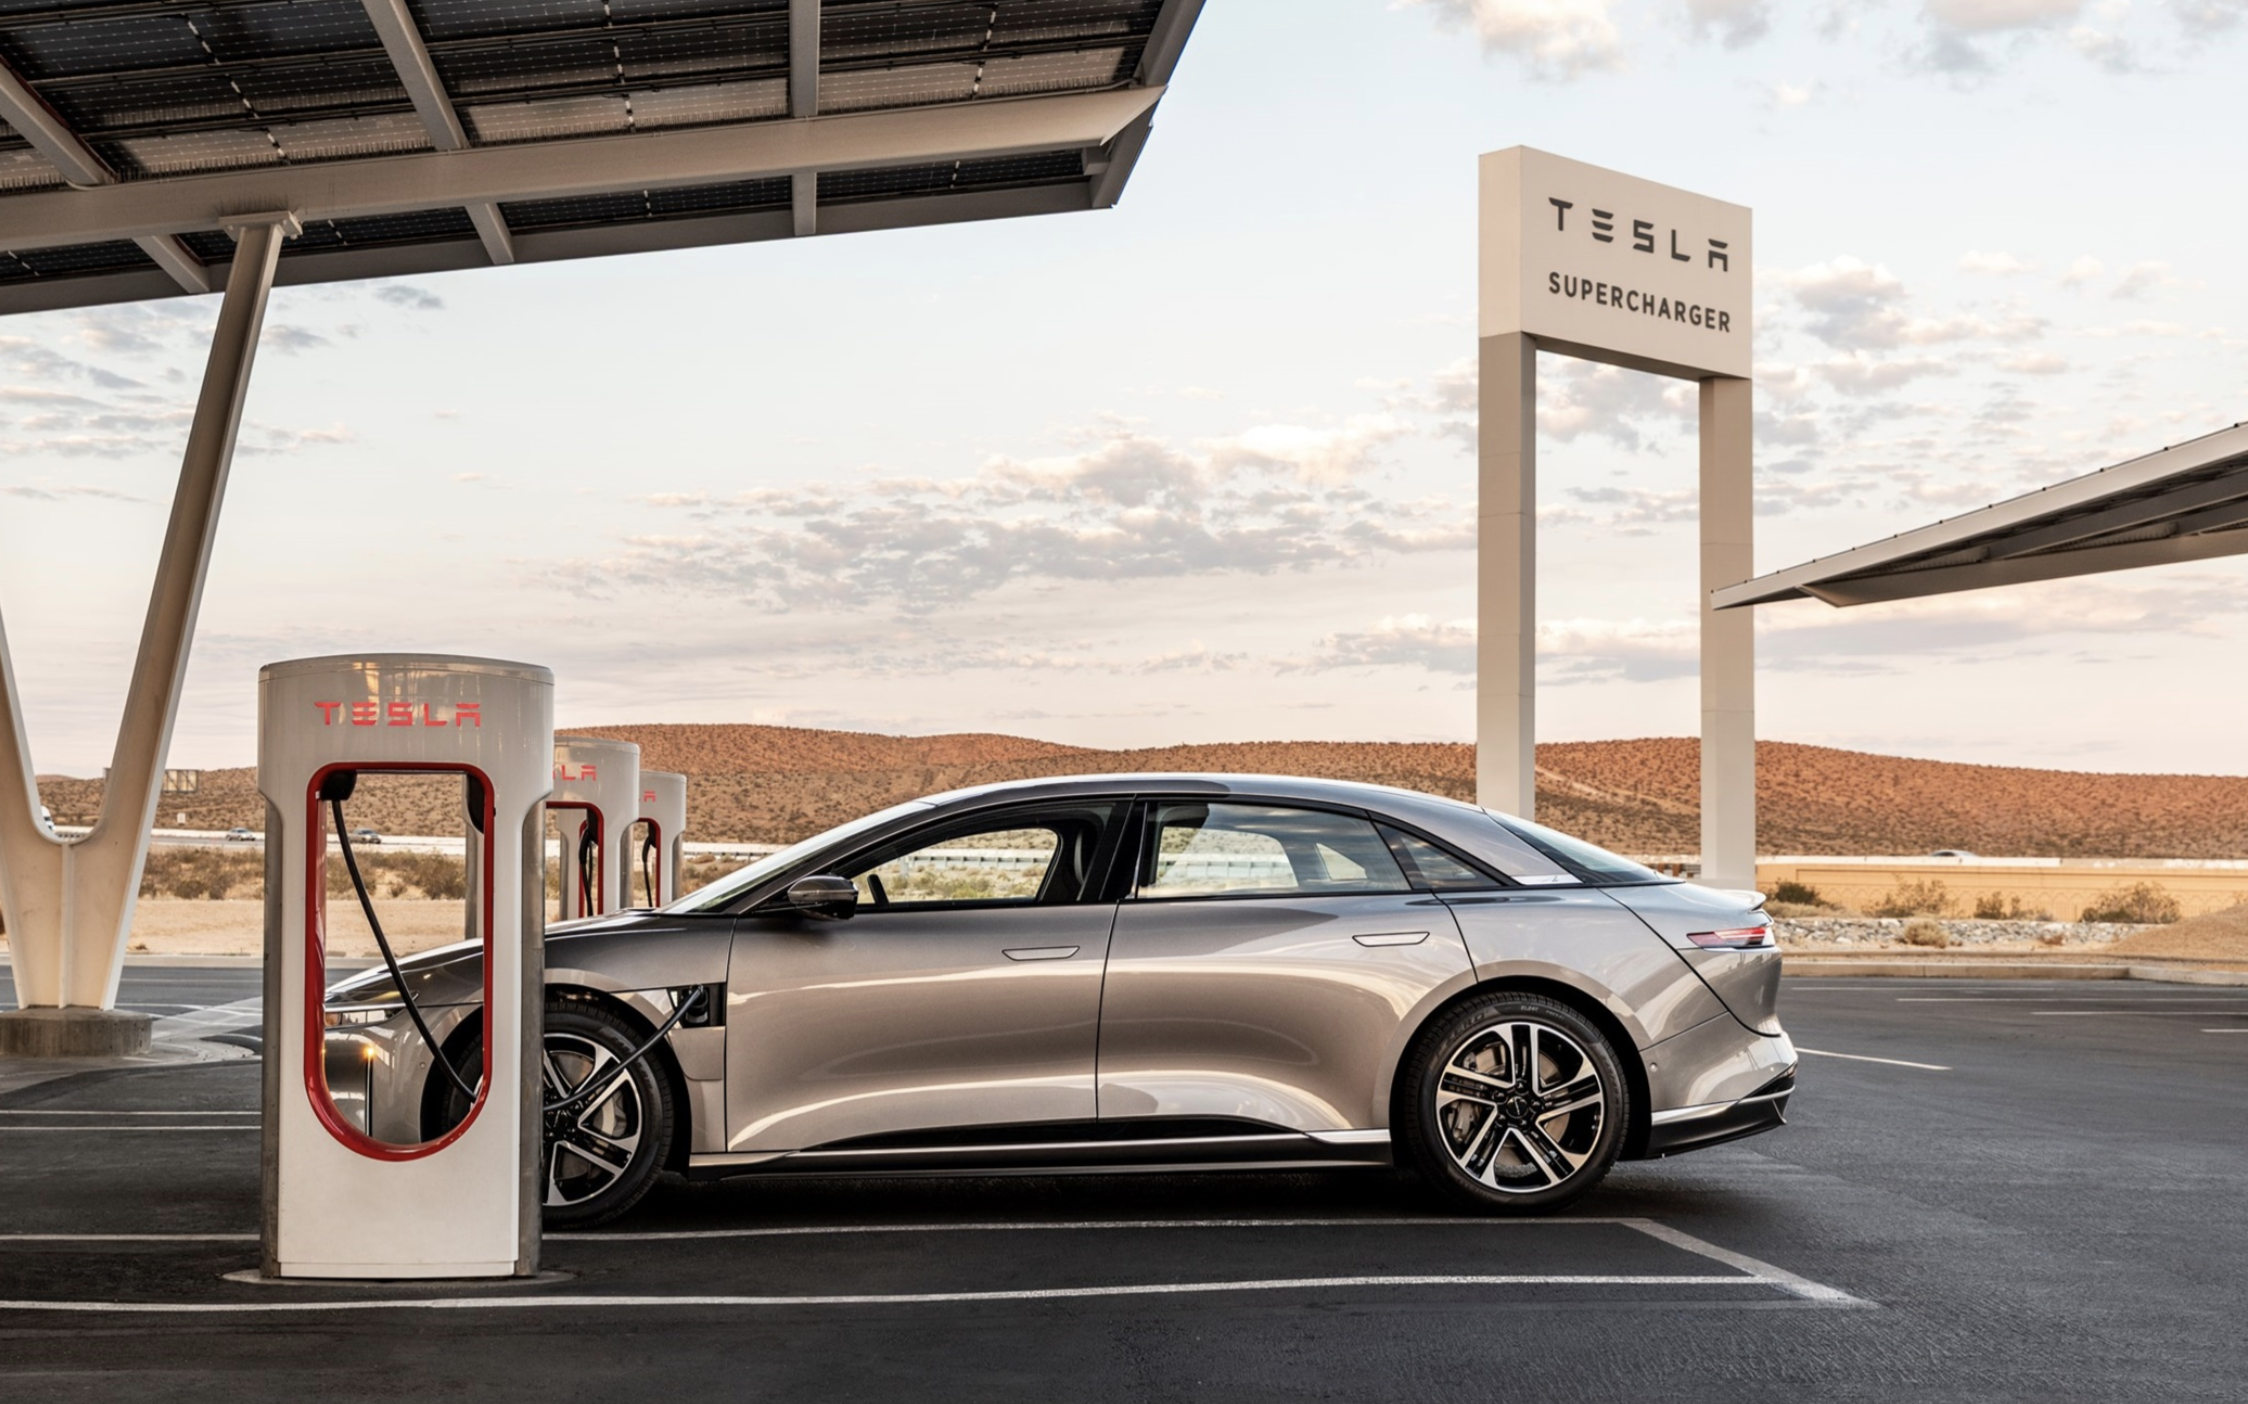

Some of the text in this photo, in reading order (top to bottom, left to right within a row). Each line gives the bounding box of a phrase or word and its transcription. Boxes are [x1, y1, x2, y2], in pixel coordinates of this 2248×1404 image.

[1548, 196, 1729, 272] TESLA
[1548, 271, 1731, 333] SUPERCHARGER
[314, 702, 481, 727] TESLA
